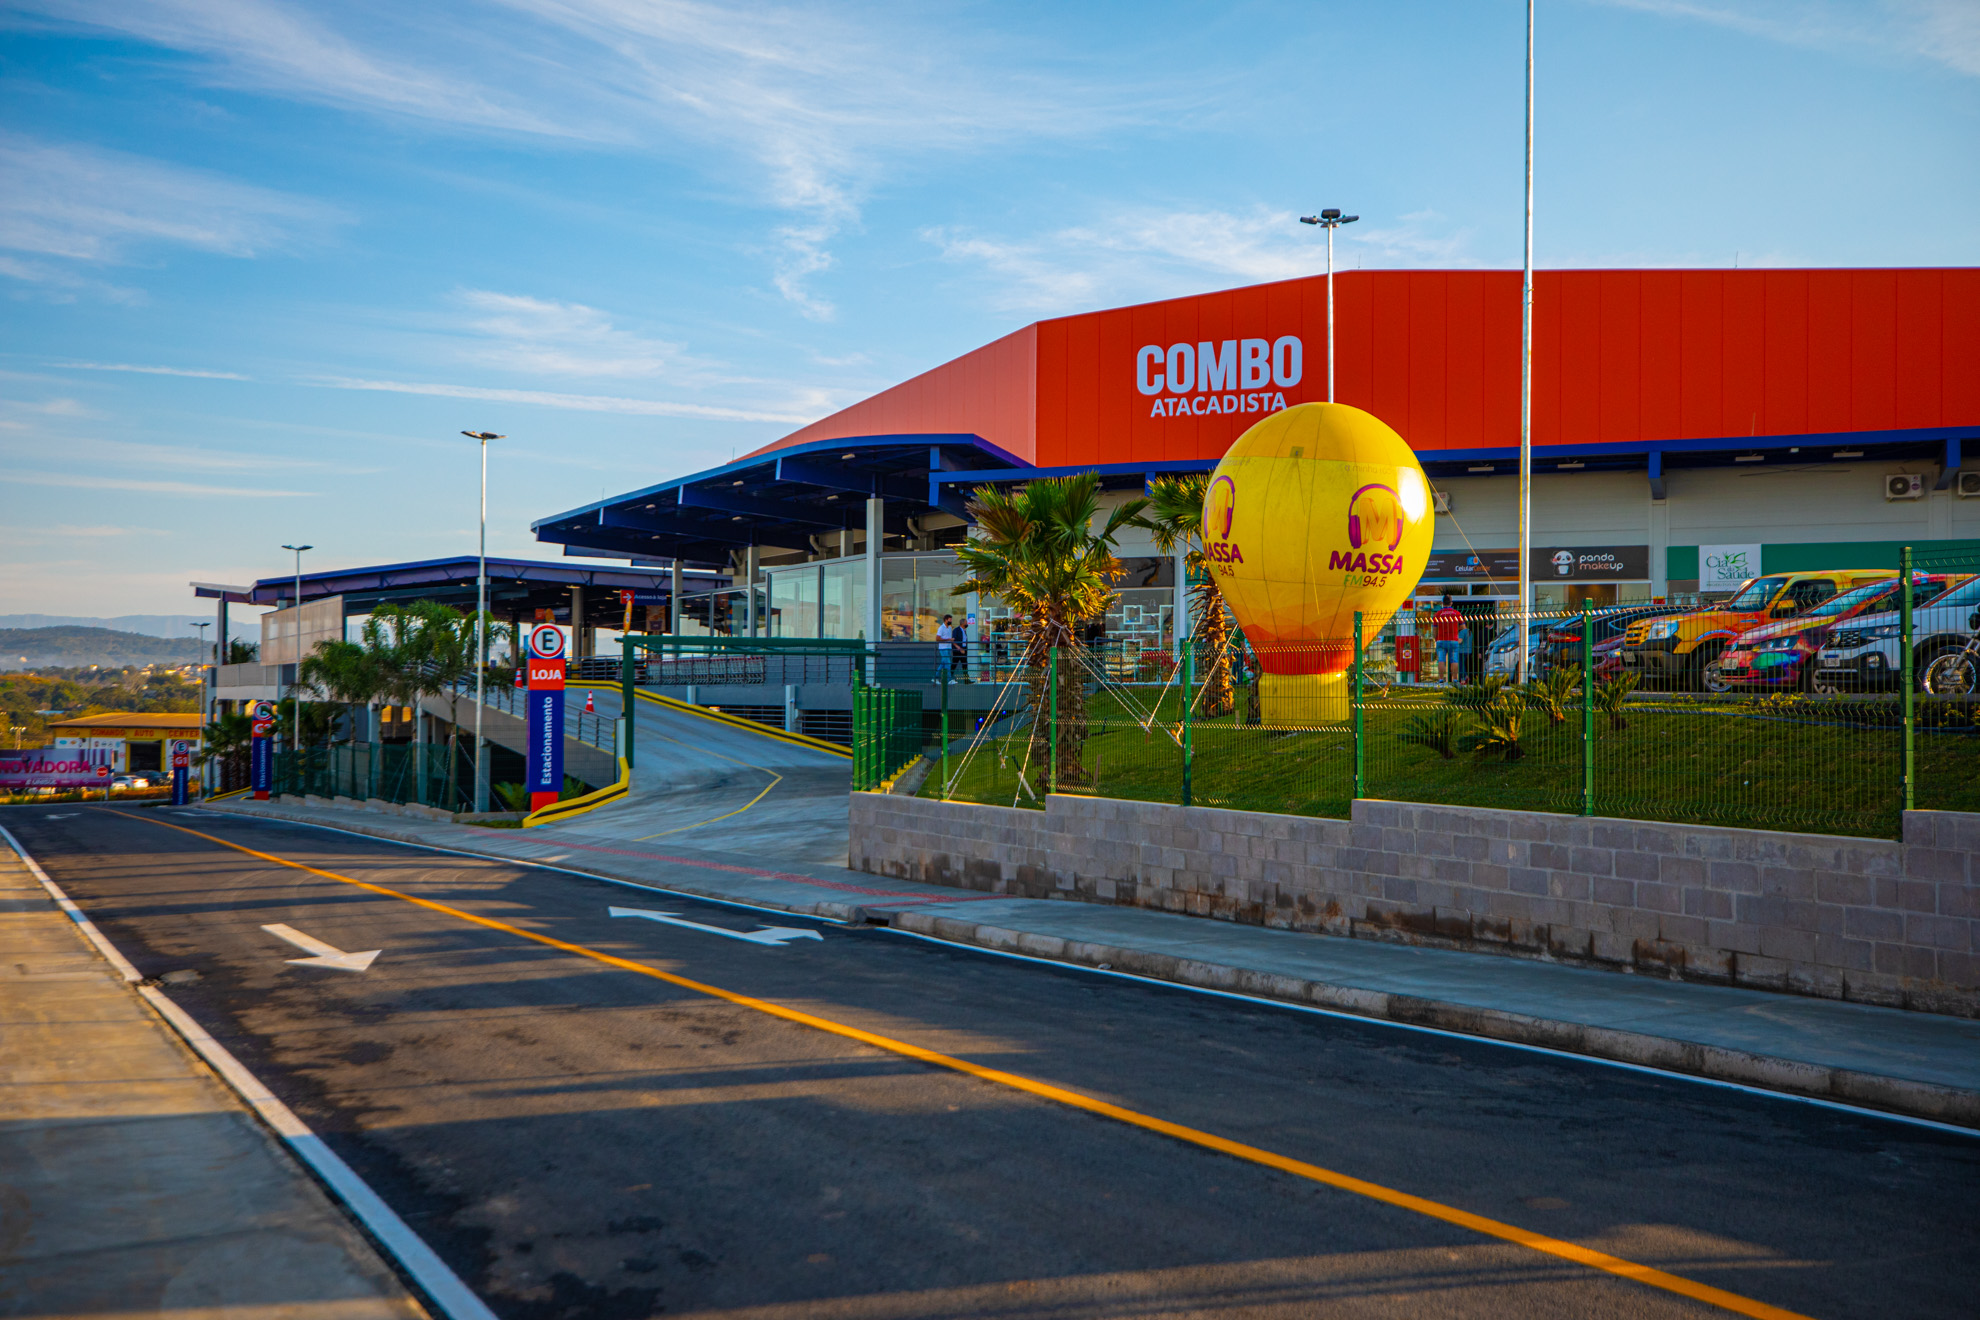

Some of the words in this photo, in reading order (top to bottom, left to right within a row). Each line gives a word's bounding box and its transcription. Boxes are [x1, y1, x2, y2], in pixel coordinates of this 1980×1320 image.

[1136, 335, 1303, 396] COMBO
[1150, 391, 1287, 418] ATACADISTA
[1328, 550, 1403, 575] MASSA
[1579, 553, 1615, 564] panda
[1706, 555, 1729, 569] Cia
[1579, 562, 1624, 571] makeup
[1717, 566, 1755, 580] Saúde
[542, 630, 554, 651] E
[531, 669, 562, 681] LOJA
[134, 729, 155, 737] AUTO
[178, 742, 185, 751] E
[540, 696, 553, 785] Estacionamento
[175, 756, 187, 765] G1
